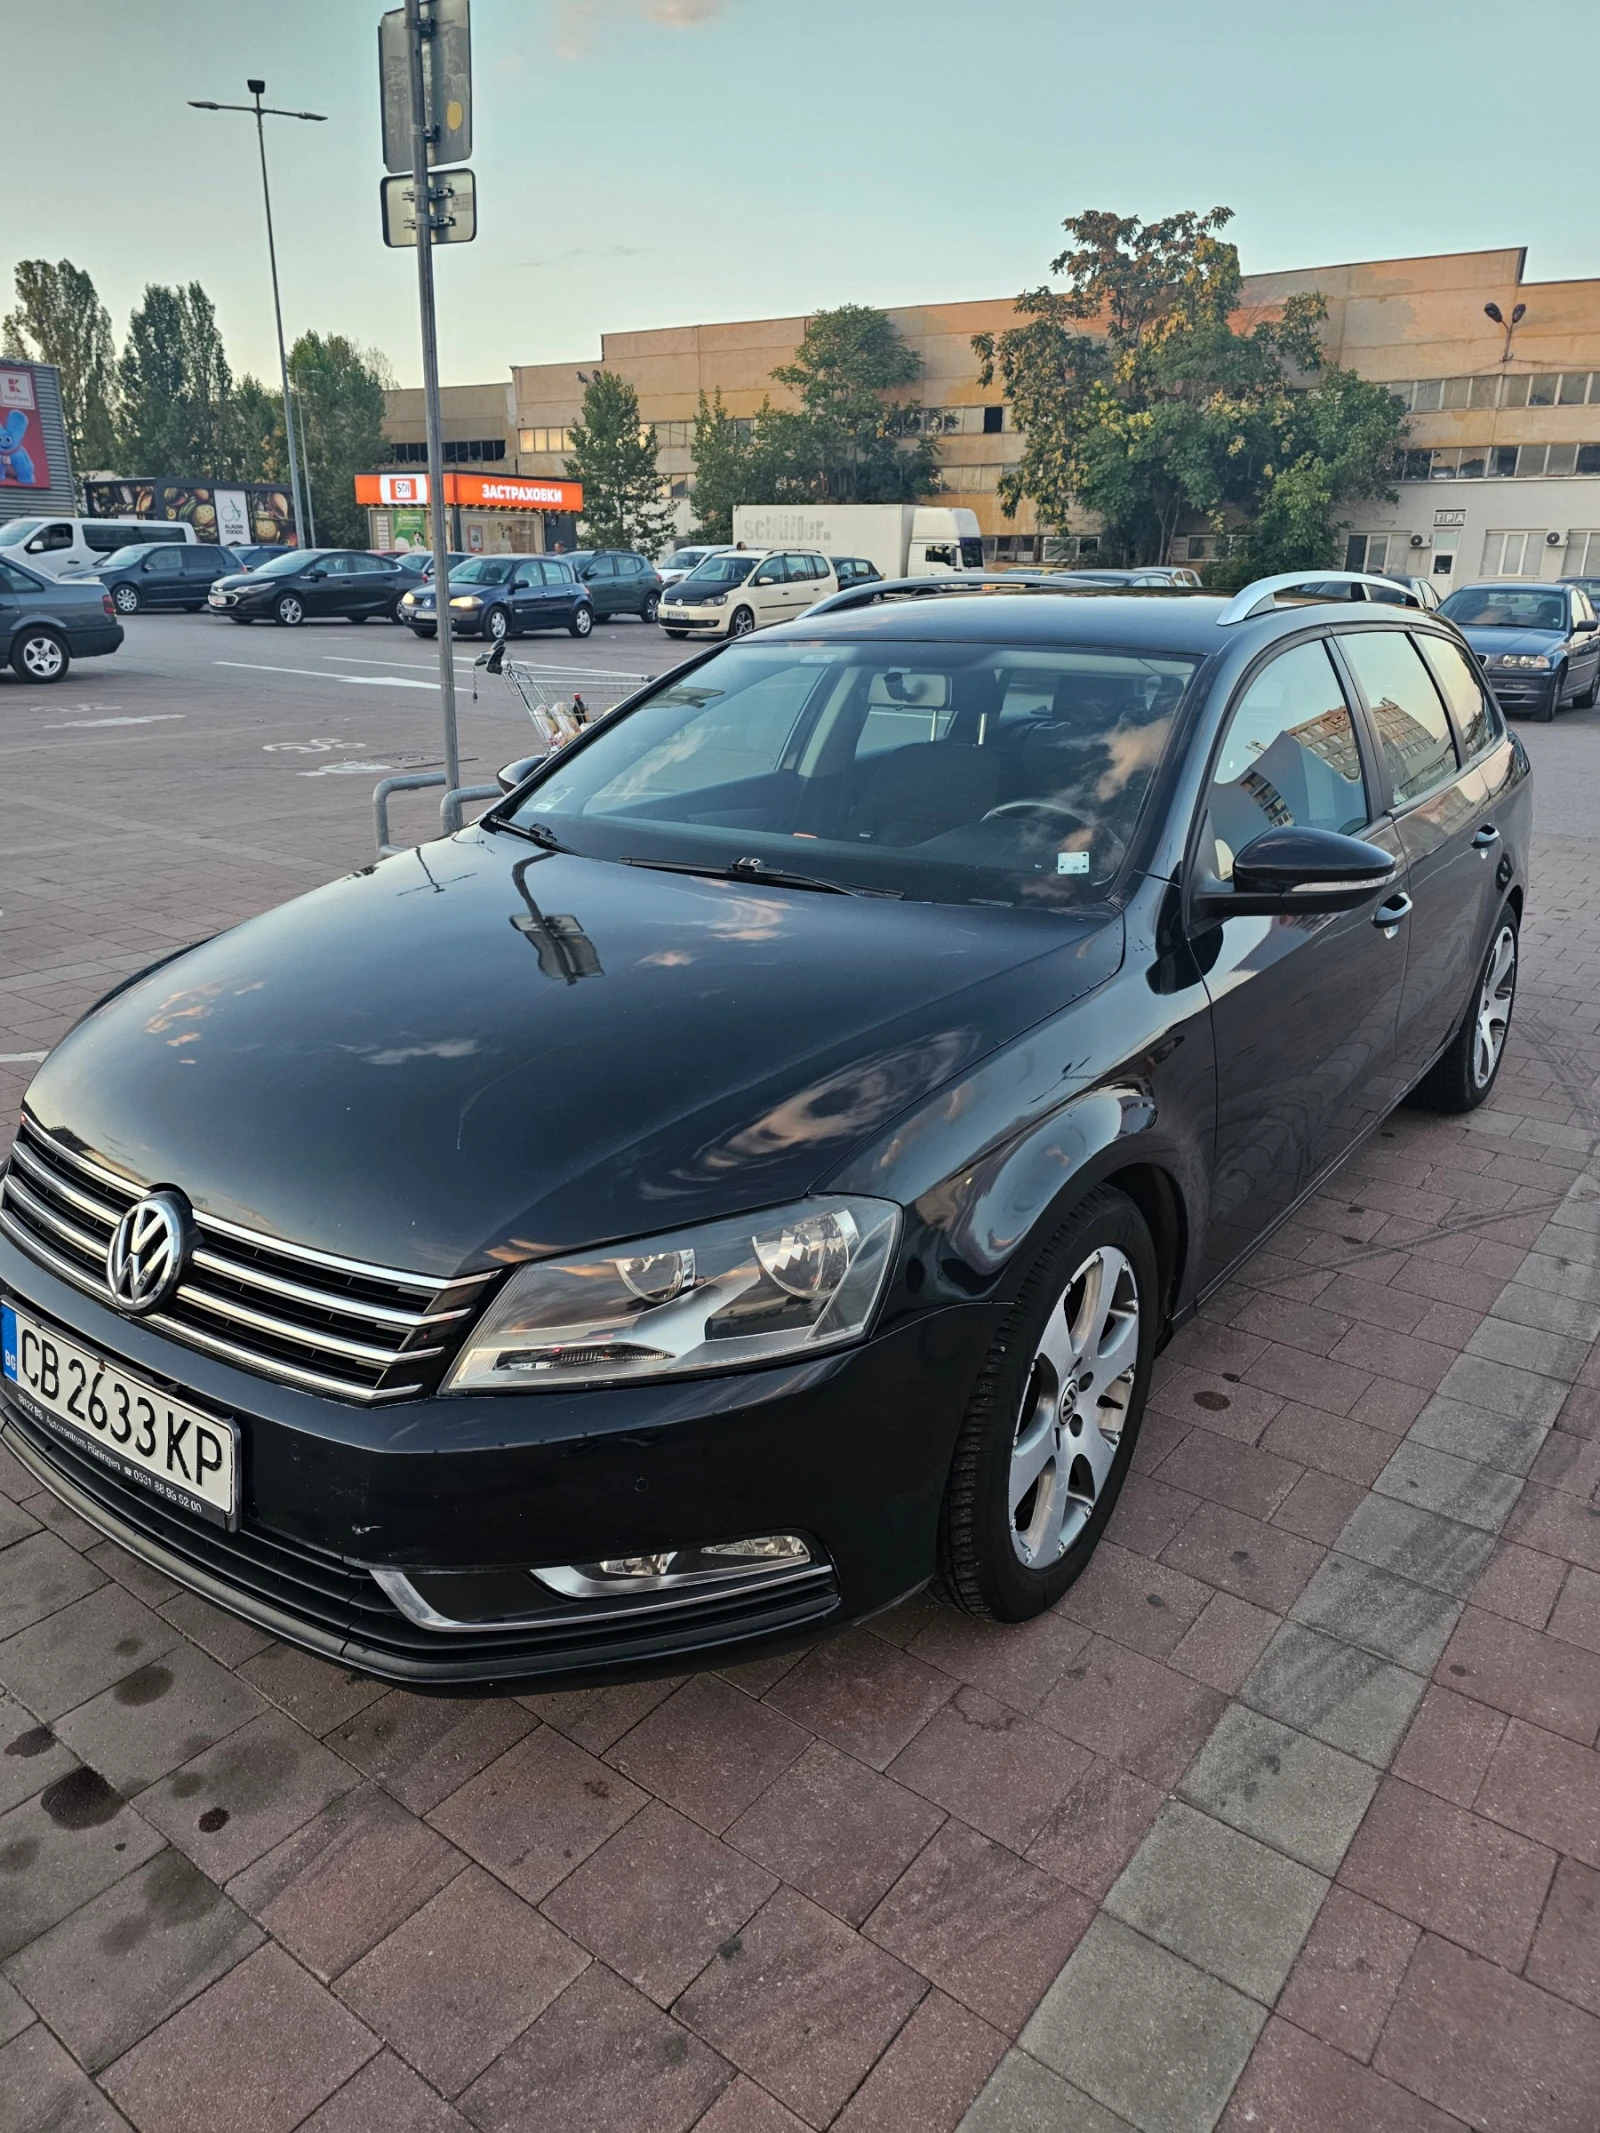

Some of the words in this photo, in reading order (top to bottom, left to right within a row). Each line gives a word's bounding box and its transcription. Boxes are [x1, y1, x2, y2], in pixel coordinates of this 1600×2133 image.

[397, 483, 409, 493] SDI
[481, 483, 562, 503] ЗАСТРАХОВКИ
[1435, 514, 1464, 523] TPA
[4, 1352, 16, 1371] BG
[133, 1469, 152, 1488] 0531
[178, 1494, 189, 1508] 52
[190, 1500, 202, 1513] 00
